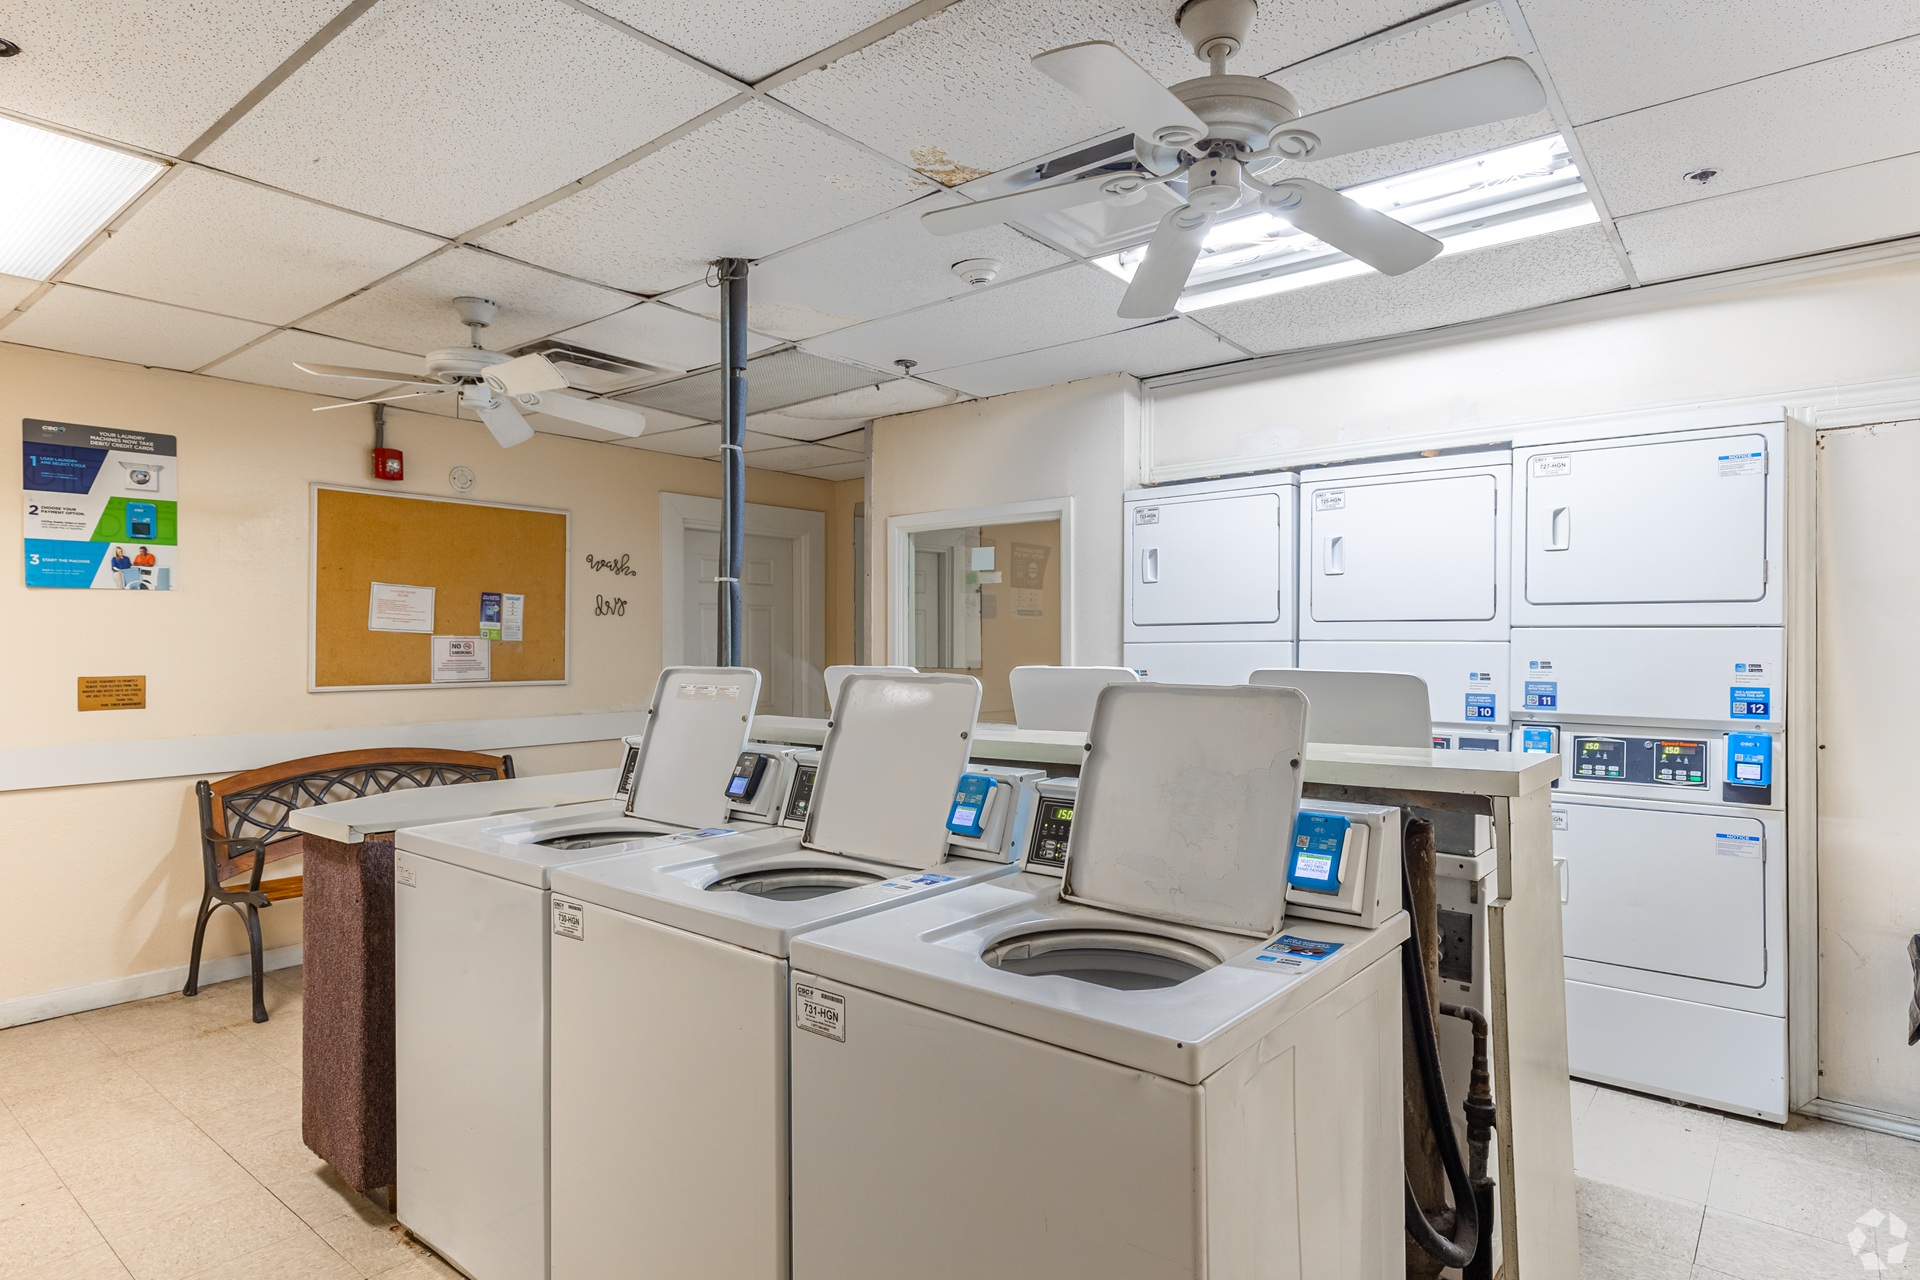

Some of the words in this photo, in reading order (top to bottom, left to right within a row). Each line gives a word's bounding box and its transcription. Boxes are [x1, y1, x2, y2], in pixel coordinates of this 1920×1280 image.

[30, 456, 36, 466] 1
[29, 505, 38, 515] 2
[30, 554, 40, 565] 3
[595, 594, 627, 616] dry
[1542, 697, 1551, 705] 11
[1480, 708, 1491, 716] 10
[1750, 704, 1764, 713] 12
[558, 914, 579, 925] 730-HGN
[798, 987, 809, 995] CSC
[804, 1003, 838, 1022] 731-HGN
